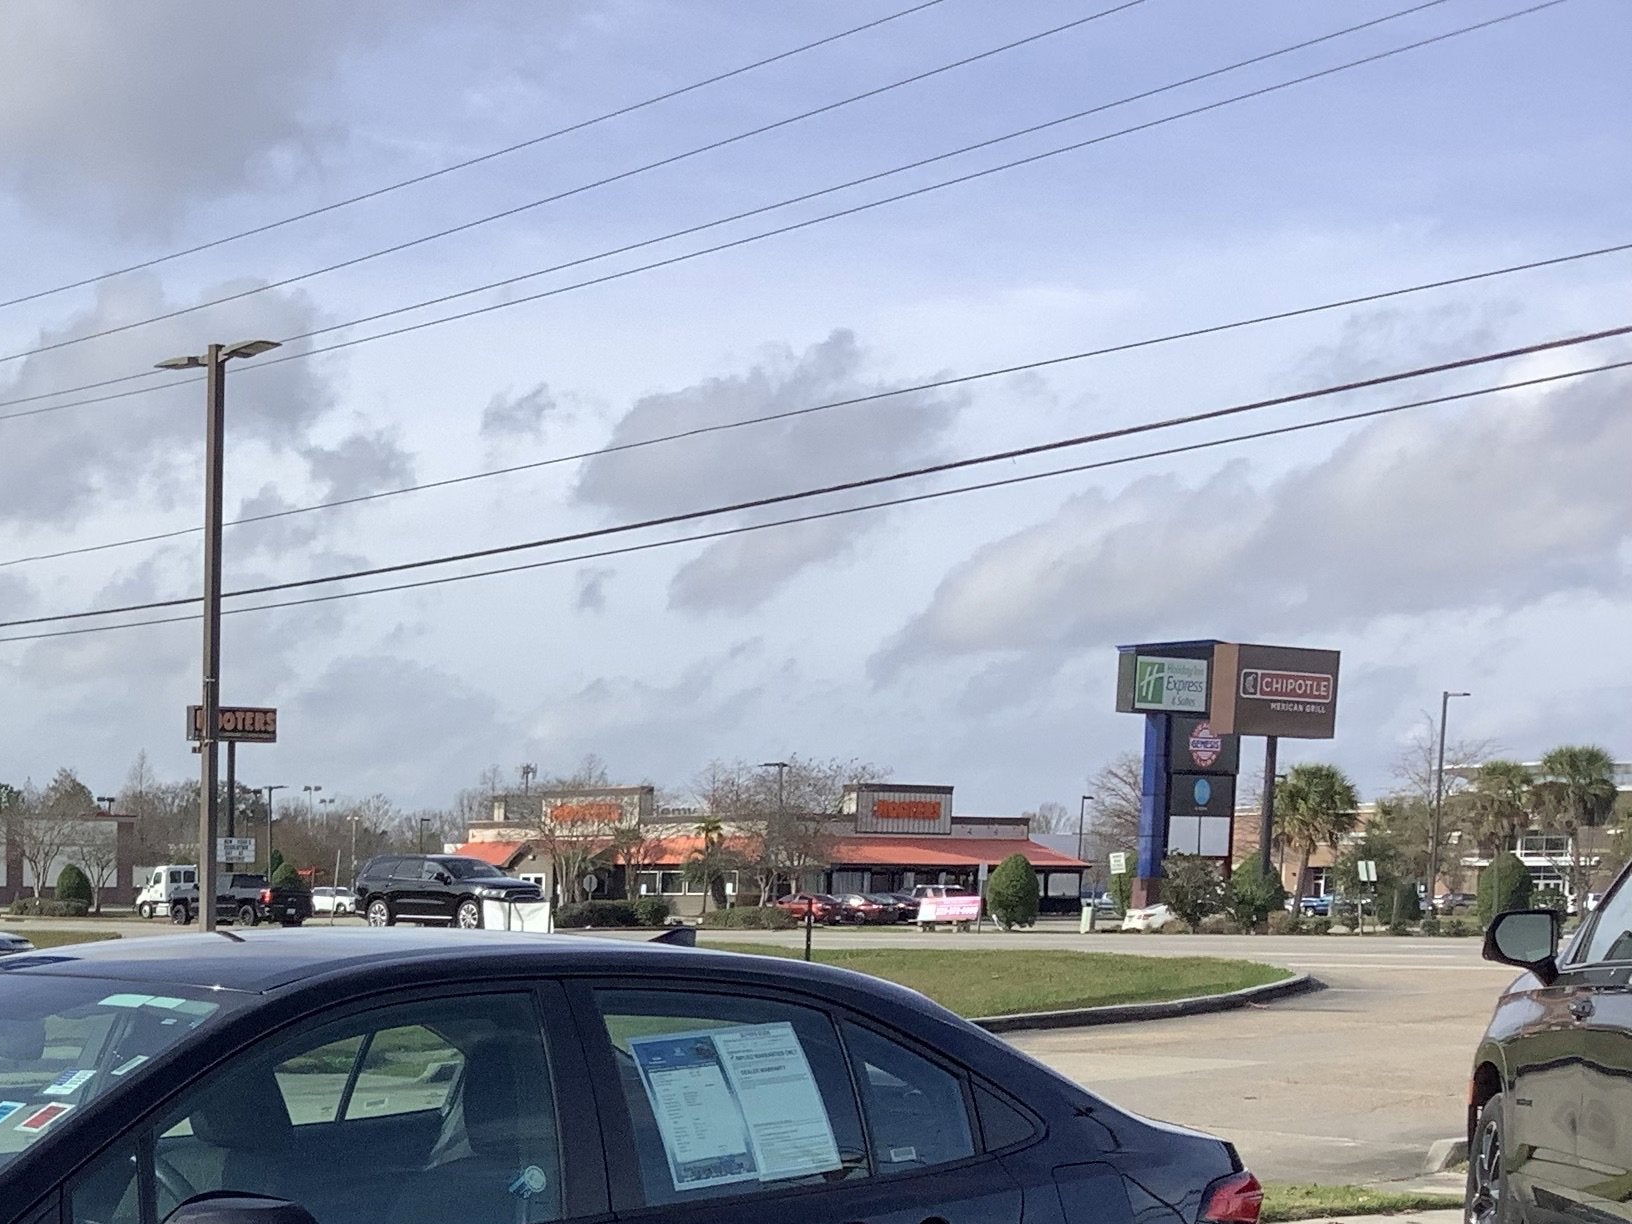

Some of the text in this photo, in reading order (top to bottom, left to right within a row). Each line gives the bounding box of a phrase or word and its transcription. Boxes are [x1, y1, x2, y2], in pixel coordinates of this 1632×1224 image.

[1165, 675, 1204, 695] Express
[1262, 677, 1329, 696] CHIPOTLE
[1270, 702, 1327, 714] MEXICAN GRILL
[196, 710, 276, 731] HOTERS
[1191, 739, 1219, 750] GENESIS
